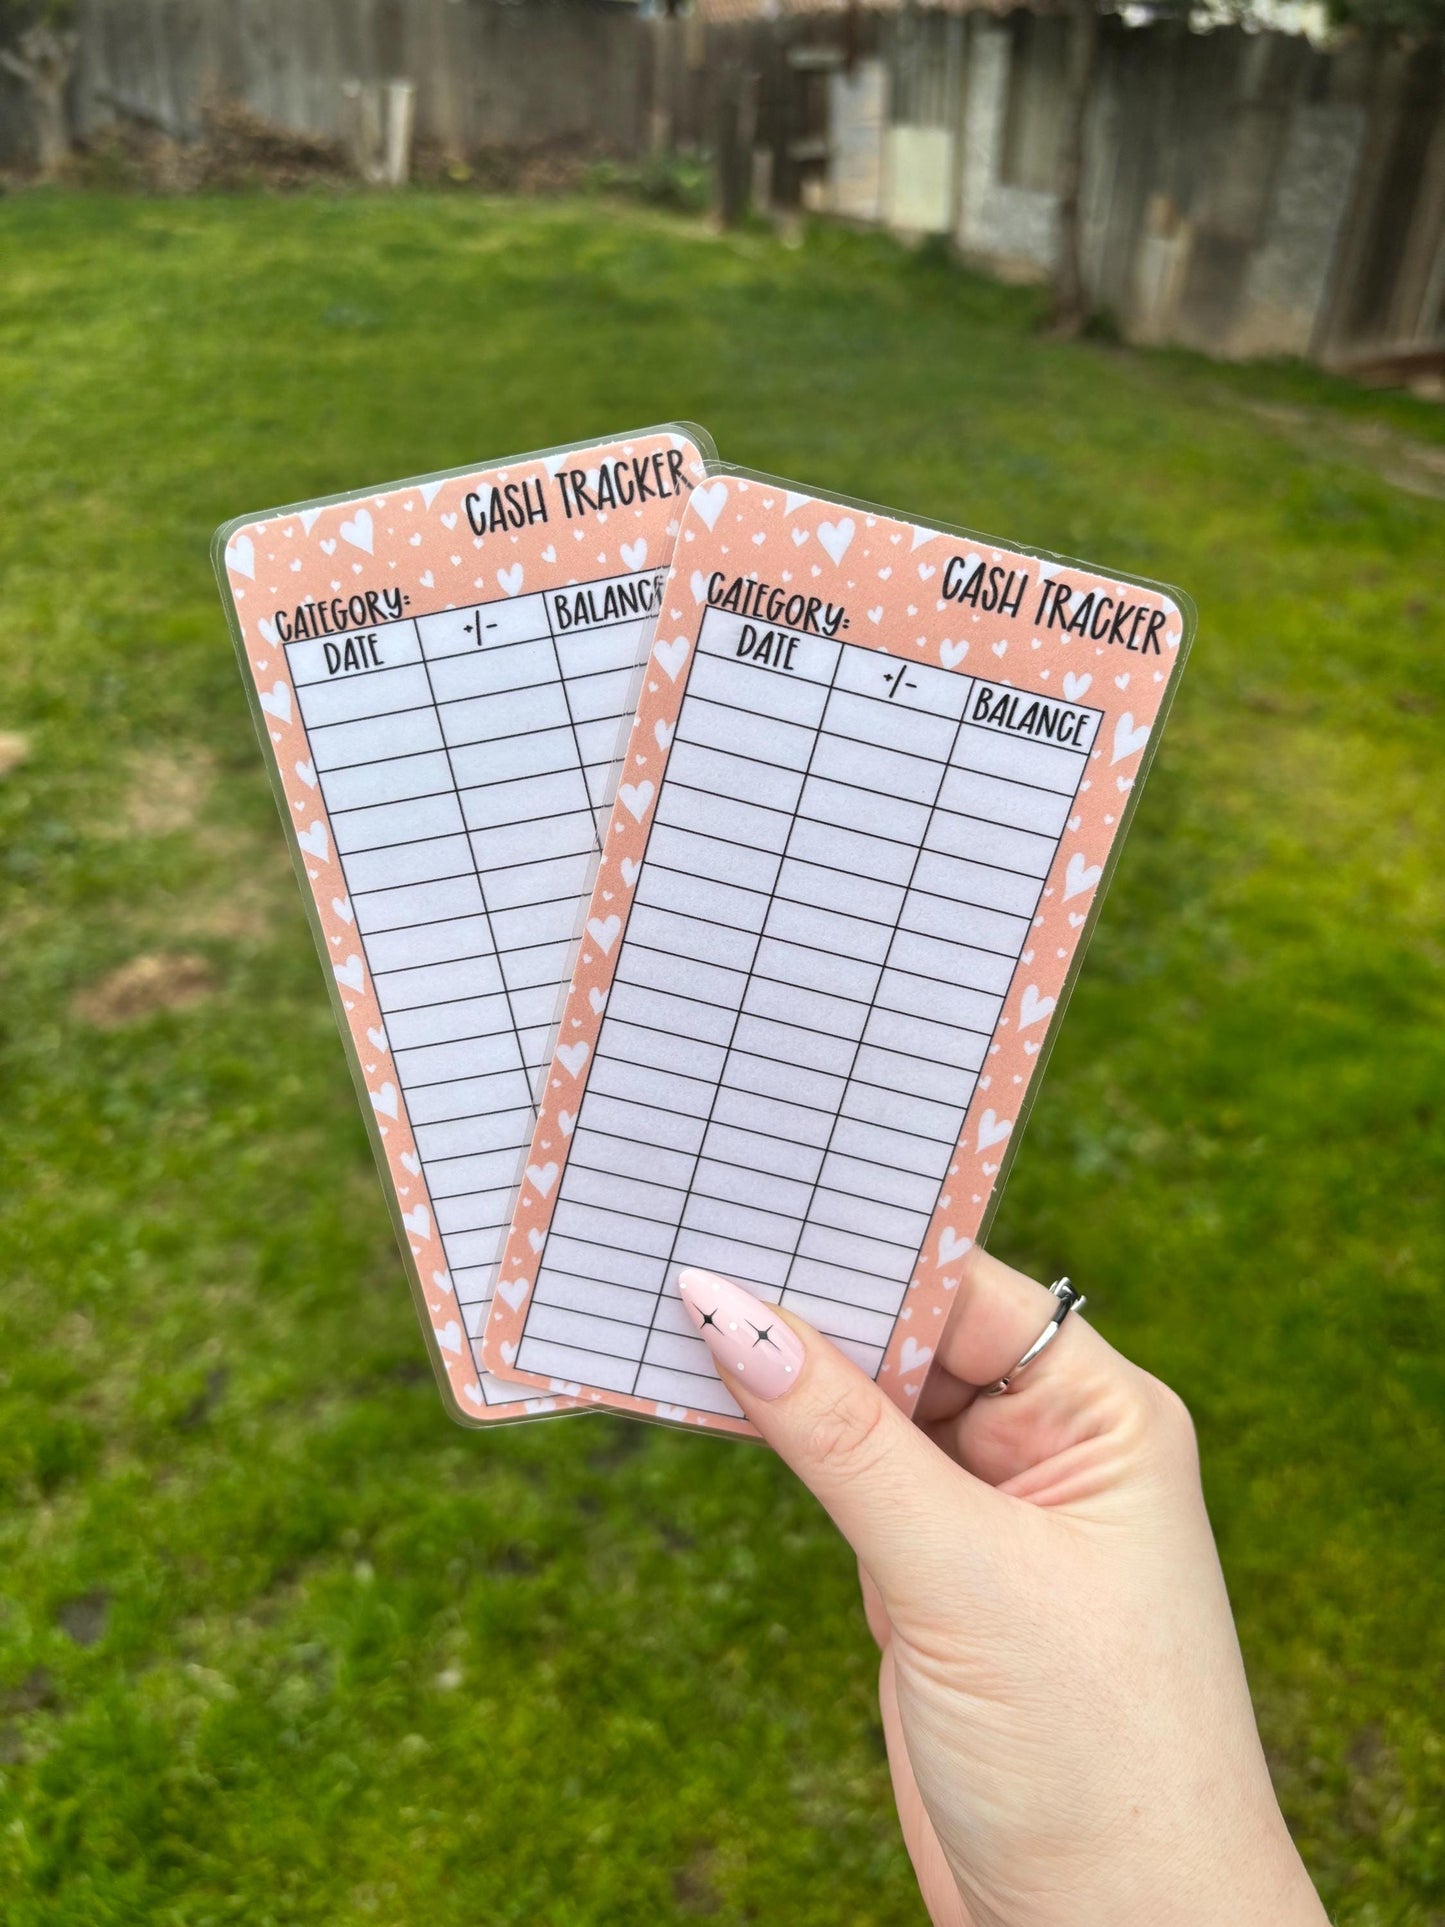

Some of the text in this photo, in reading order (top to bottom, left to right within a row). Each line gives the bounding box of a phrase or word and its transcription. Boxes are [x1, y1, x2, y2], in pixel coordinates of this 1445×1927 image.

[465, 448, 694, 537] CASH TRACKER
[274, 586, 411, 642] CATEGORY:
[706, 571, 851, 637] CATEGORY:
[941, 555, 1168, 657] CASH TRACKER
[322, 633, 385, 676] DATE
[736, 623, 802, 672] DATE
[972, 687, 1090, 748] BALANCE
